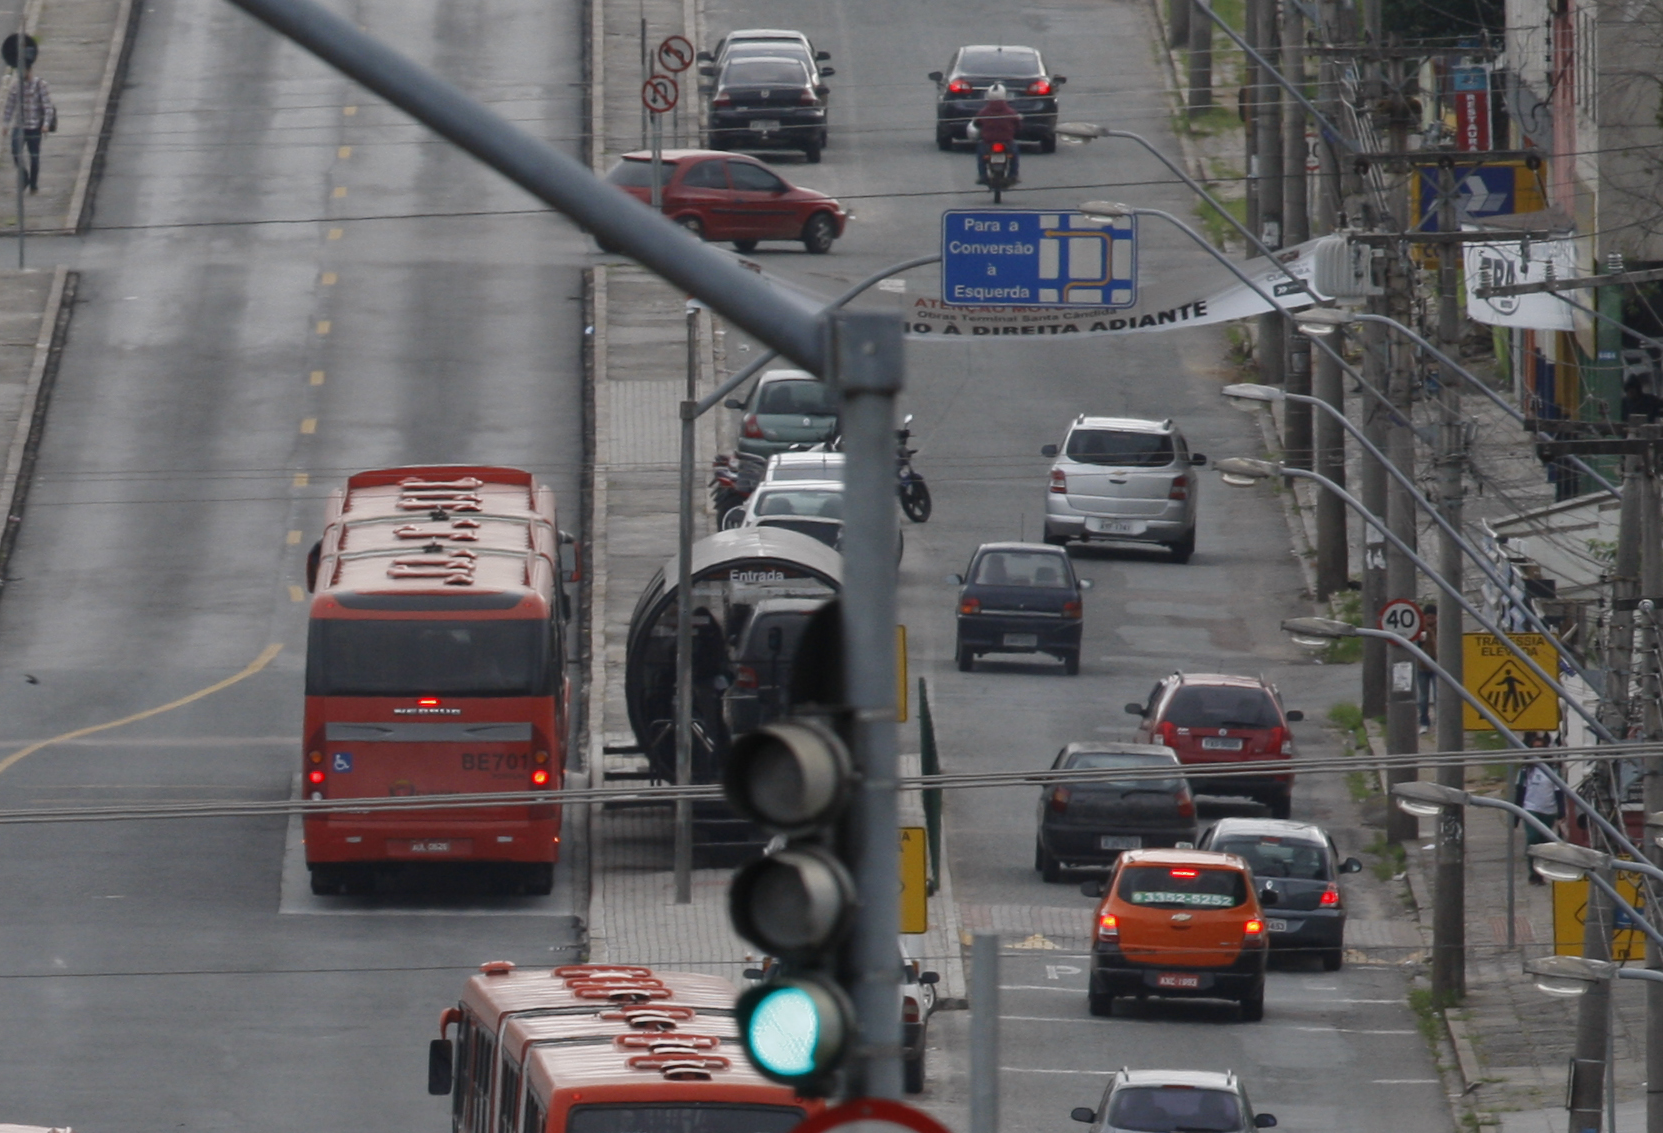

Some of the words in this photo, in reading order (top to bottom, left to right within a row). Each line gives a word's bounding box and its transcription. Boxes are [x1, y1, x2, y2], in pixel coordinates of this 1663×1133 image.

[964, 218, 1001, 231] Para
[1009, 221, 1019, 231] a
[949, 241, 1034, 255] Conversão
[988, 263, 997, 276] à
[954, 285, 1030, 300] Esquerda
[917, 311, 957, 321] Obras
[962, 314, 1018, 322] Terminal
[1022, 314, 1060, 322] Santa
[943, 322, 962, 335] À
[972, 323, 1079, 336] DIREITA
[1090, 301, 1208, 331] ADIANTE
[729, 569, 785, 582] Entrada
[1386, 609, 1415, 629] 40
[1475, 635, 1545, 647] TRAESSIA
[1481, 646, 1539, 657] ELEVDA
[461, 753, 529, 771] BE701
[1144, 892, 1234, 906] 3352-5252
